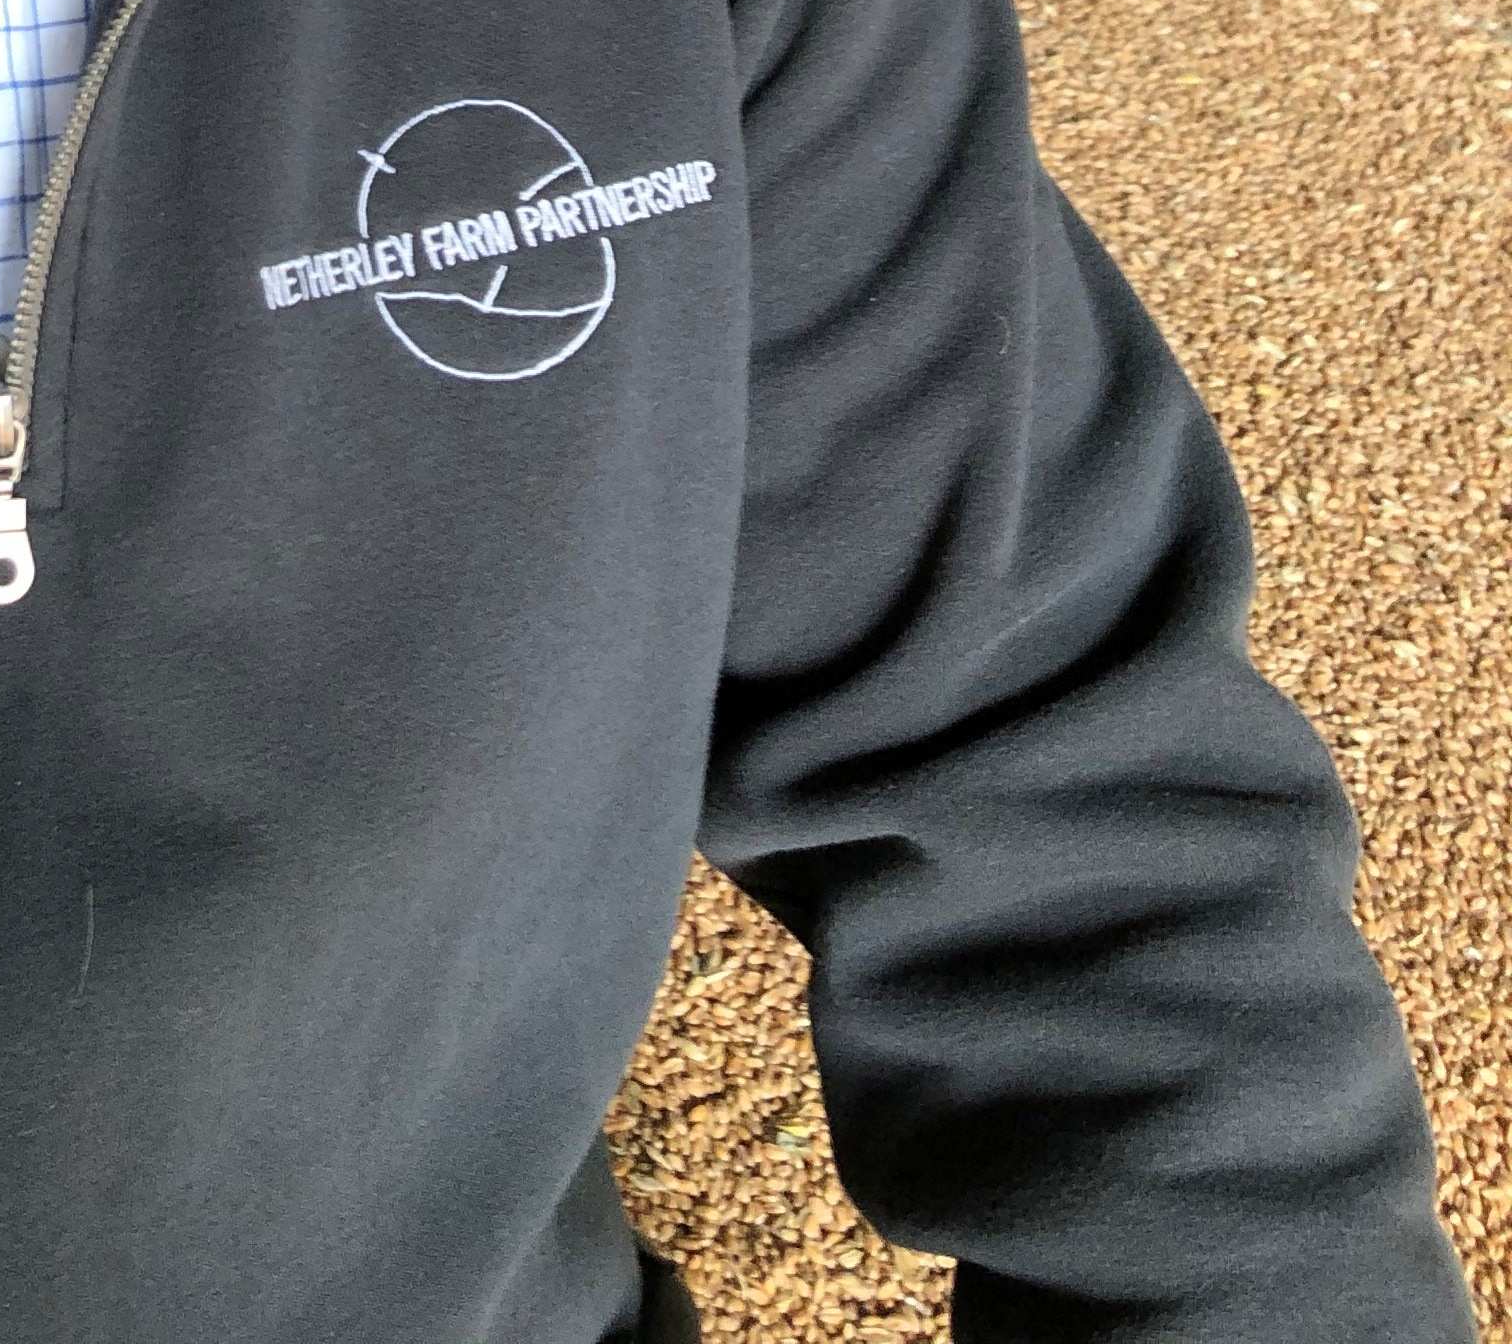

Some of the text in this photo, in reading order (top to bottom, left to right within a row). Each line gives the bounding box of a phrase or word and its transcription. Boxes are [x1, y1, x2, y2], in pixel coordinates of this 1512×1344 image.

[259, 159, 718, 311] NETHERLEY FARM PARTNERSHIP
